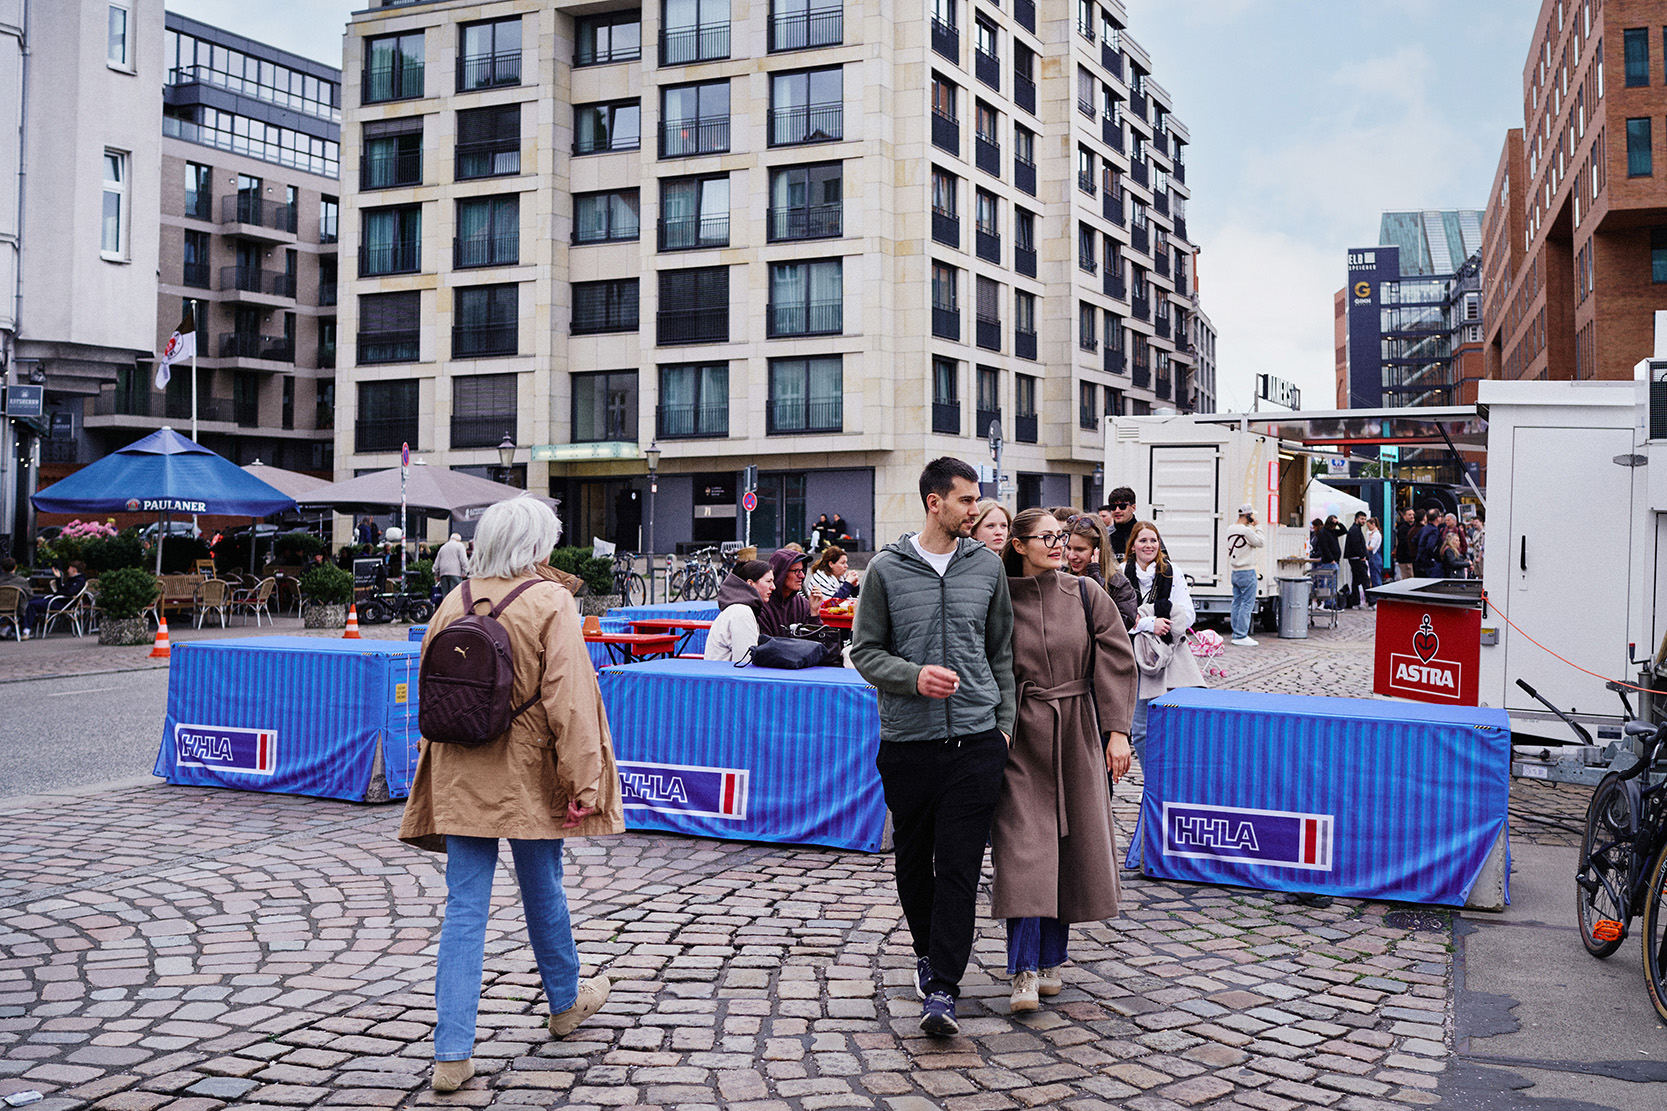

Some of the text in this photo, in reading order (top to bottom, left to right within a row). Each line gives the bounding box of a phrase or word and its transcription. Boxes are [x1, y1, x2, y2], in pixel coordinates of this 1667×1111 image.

[1348, 253, 1363, 265] ELB
[1354, 281, 1371, 298] G
[143, 500, 206, 512] PAULANER
[1395, 663, 1454, 688] ASTRA
[181, 733, 233, 761] HHLA
[619, 772, 688, 803] HHLA
[1175, 815, 1259, 851] HHLA
